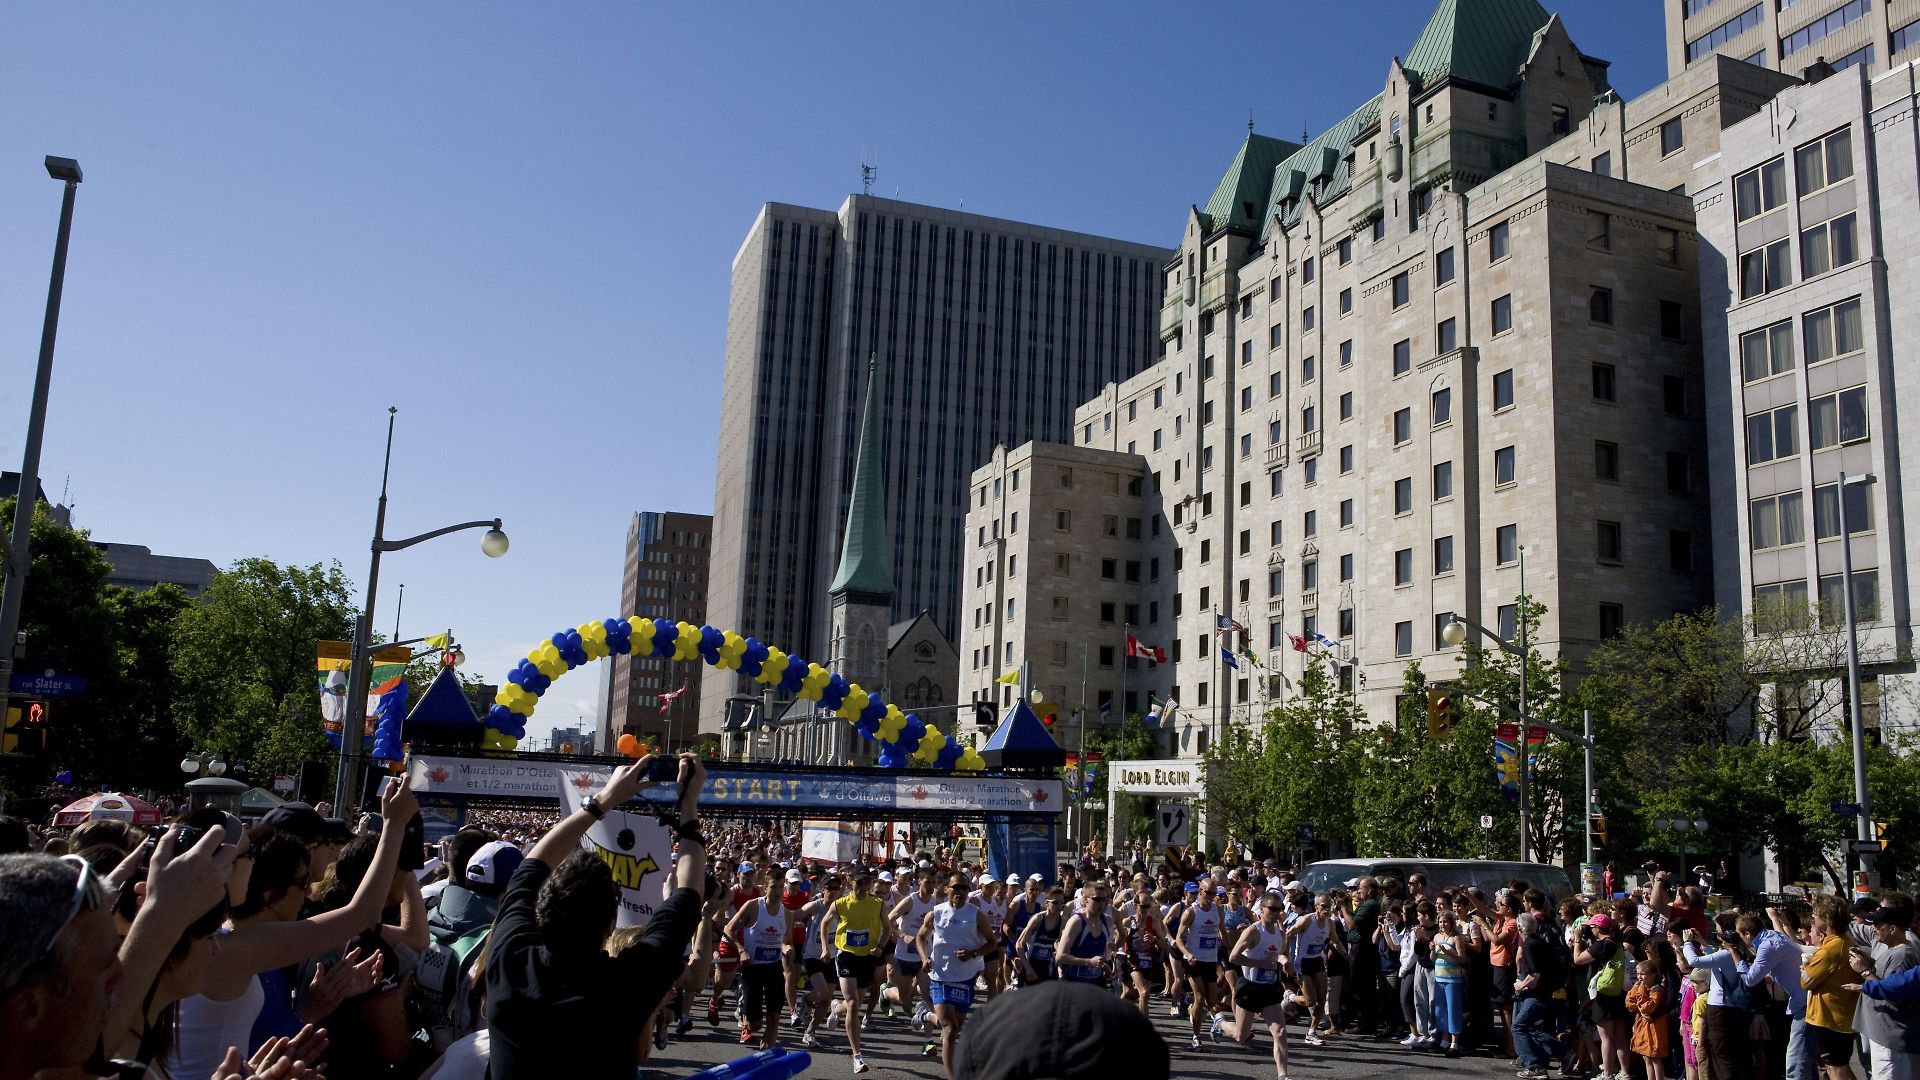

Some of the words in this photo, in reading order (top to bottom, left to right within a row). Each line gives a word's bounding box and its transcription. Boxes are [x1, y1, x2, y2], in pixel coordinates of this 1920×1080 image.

[35, 678, 63, 690] Slater
[459, 764, 513, 776] Marathon
[467, 780, 478, 789] et
[483, 779, 500, 791] 1/2
[504, 780, 556, 792] marathon
[714, 777, 801, 801] START
[939, 783, 974, 794] Ottawa
[977, 784, 1021, 795] Marathon
[939, 796, 957, 806] and
[961, 797, 975, 807] 1/2
[978, 798, 1022, 808] marathon
[622, 897, 653, 916] fresh
